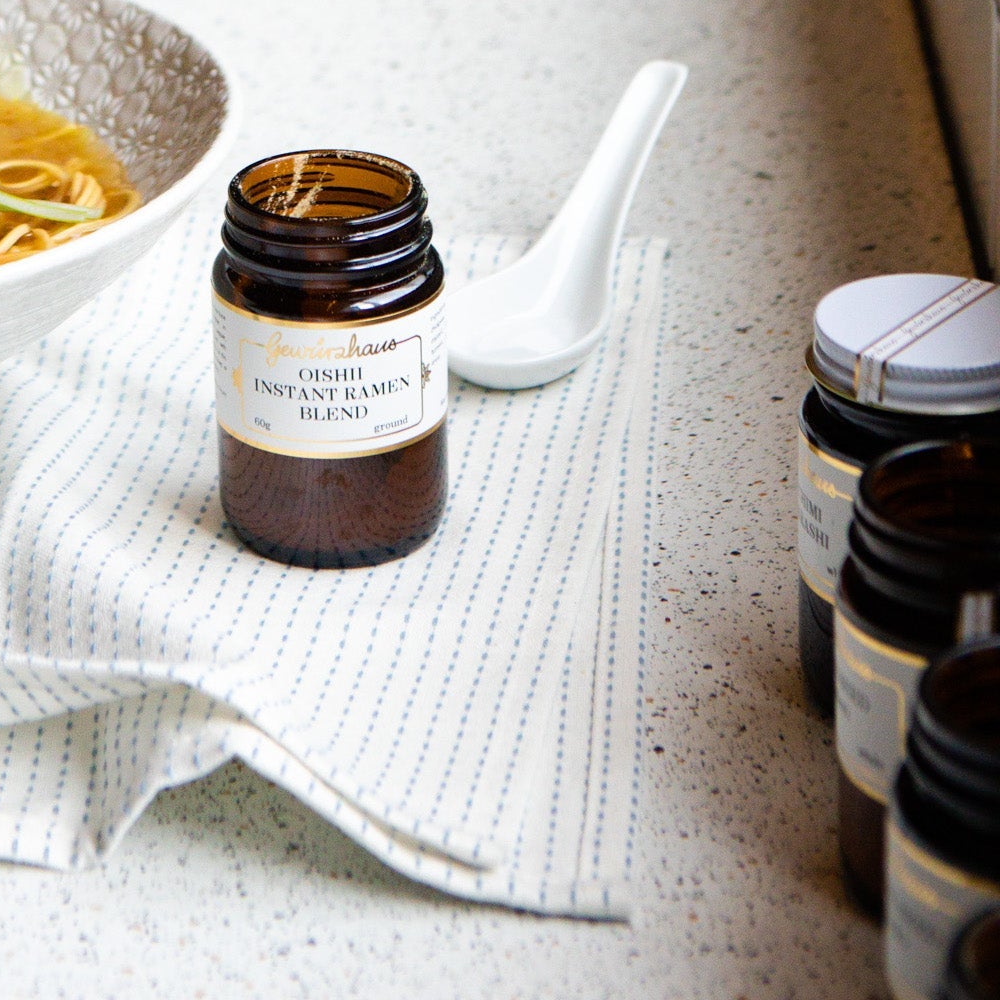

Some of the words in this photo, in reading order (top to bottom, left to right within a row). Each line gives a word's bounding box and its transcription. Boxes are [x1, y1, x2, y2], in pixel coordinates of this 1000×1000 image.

[299, 367, 362, 382] OISHII
[254, 378, 338, 401] INSTANT
[345, 374, 410, 400] RAMEN
[300, 405, 368, 421] BLEND
[254, 416, 271, 430] 60g
[374, 414, 408, 433] ground
